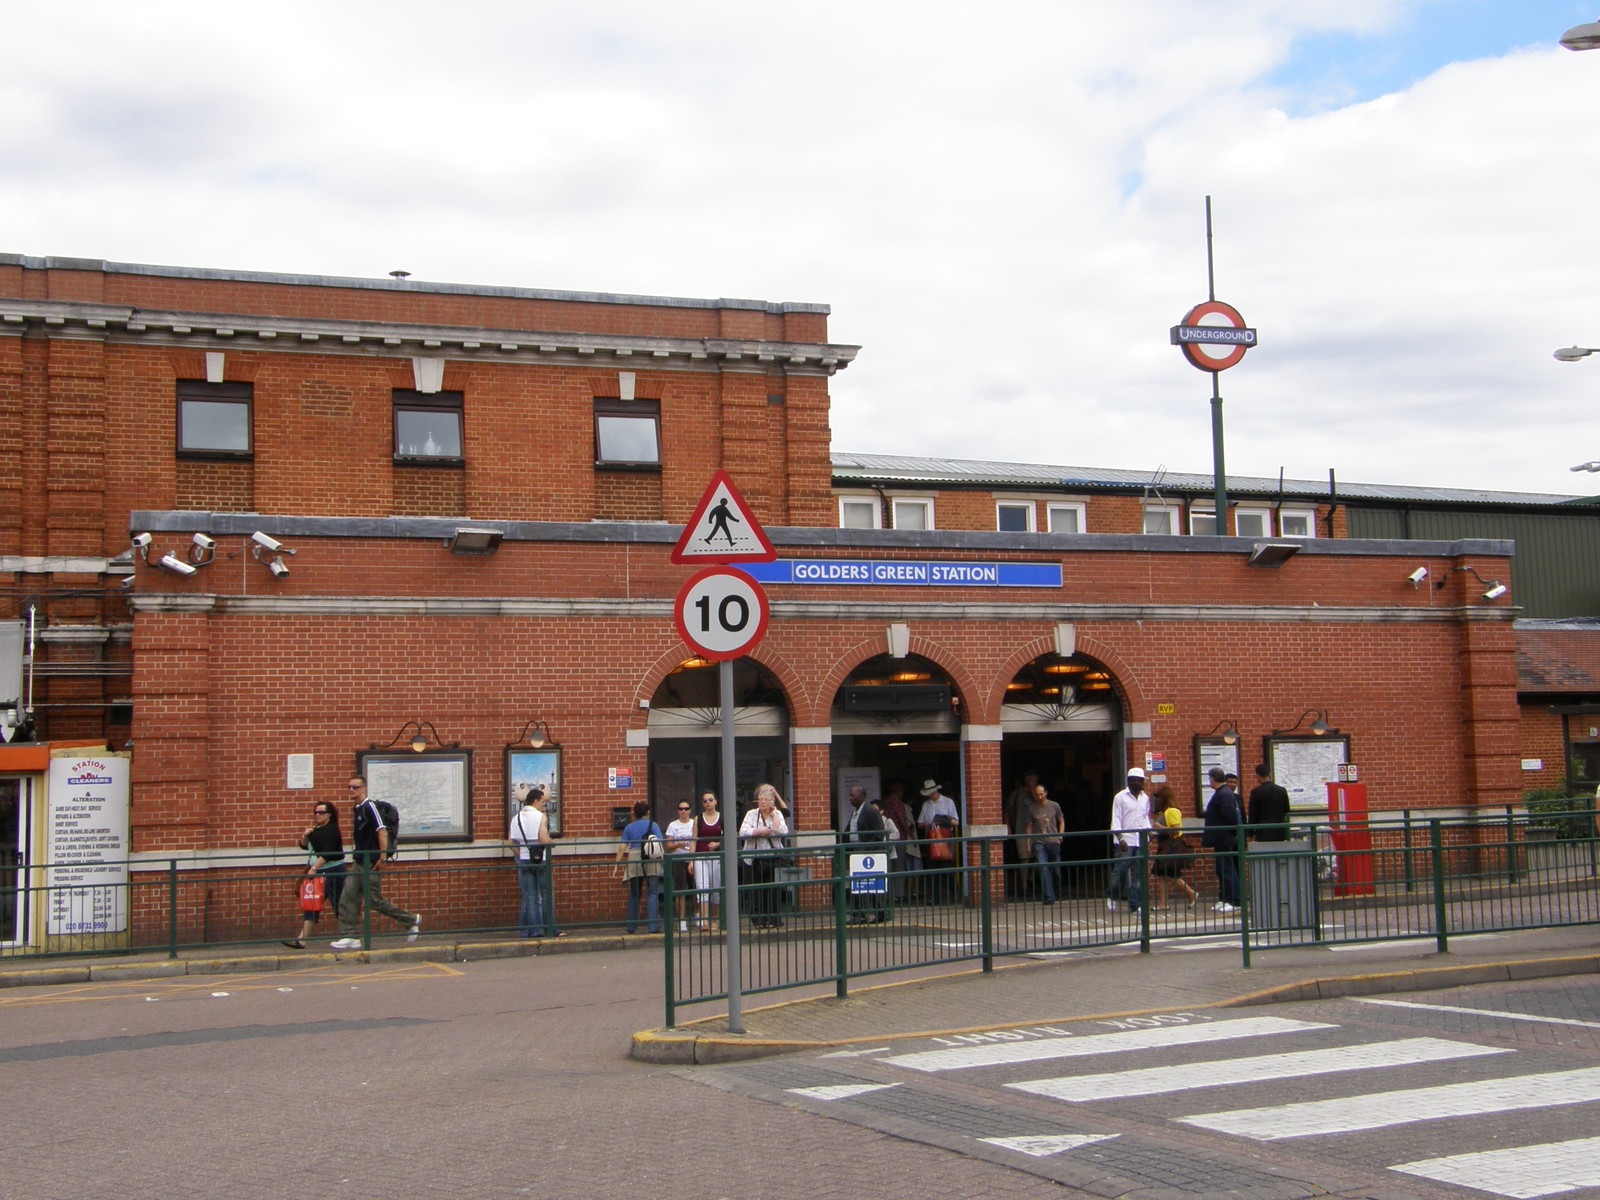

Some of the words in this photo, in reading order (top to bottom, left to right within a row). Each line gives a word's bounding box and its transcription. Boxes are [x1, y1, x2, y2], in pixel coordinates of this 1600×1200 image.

[1179, 328, 1254, 342] UNDERGROUND
[795, 564, 869, 579] GOLDERS
[875, 565, 926, 580] GREEN
[932, 566, 996, 581] STATION
[695, 594, 750, 633] 10
[72, 761, 106, 772] STATION
[931, 1026, 1073, 1047] RIGHT
